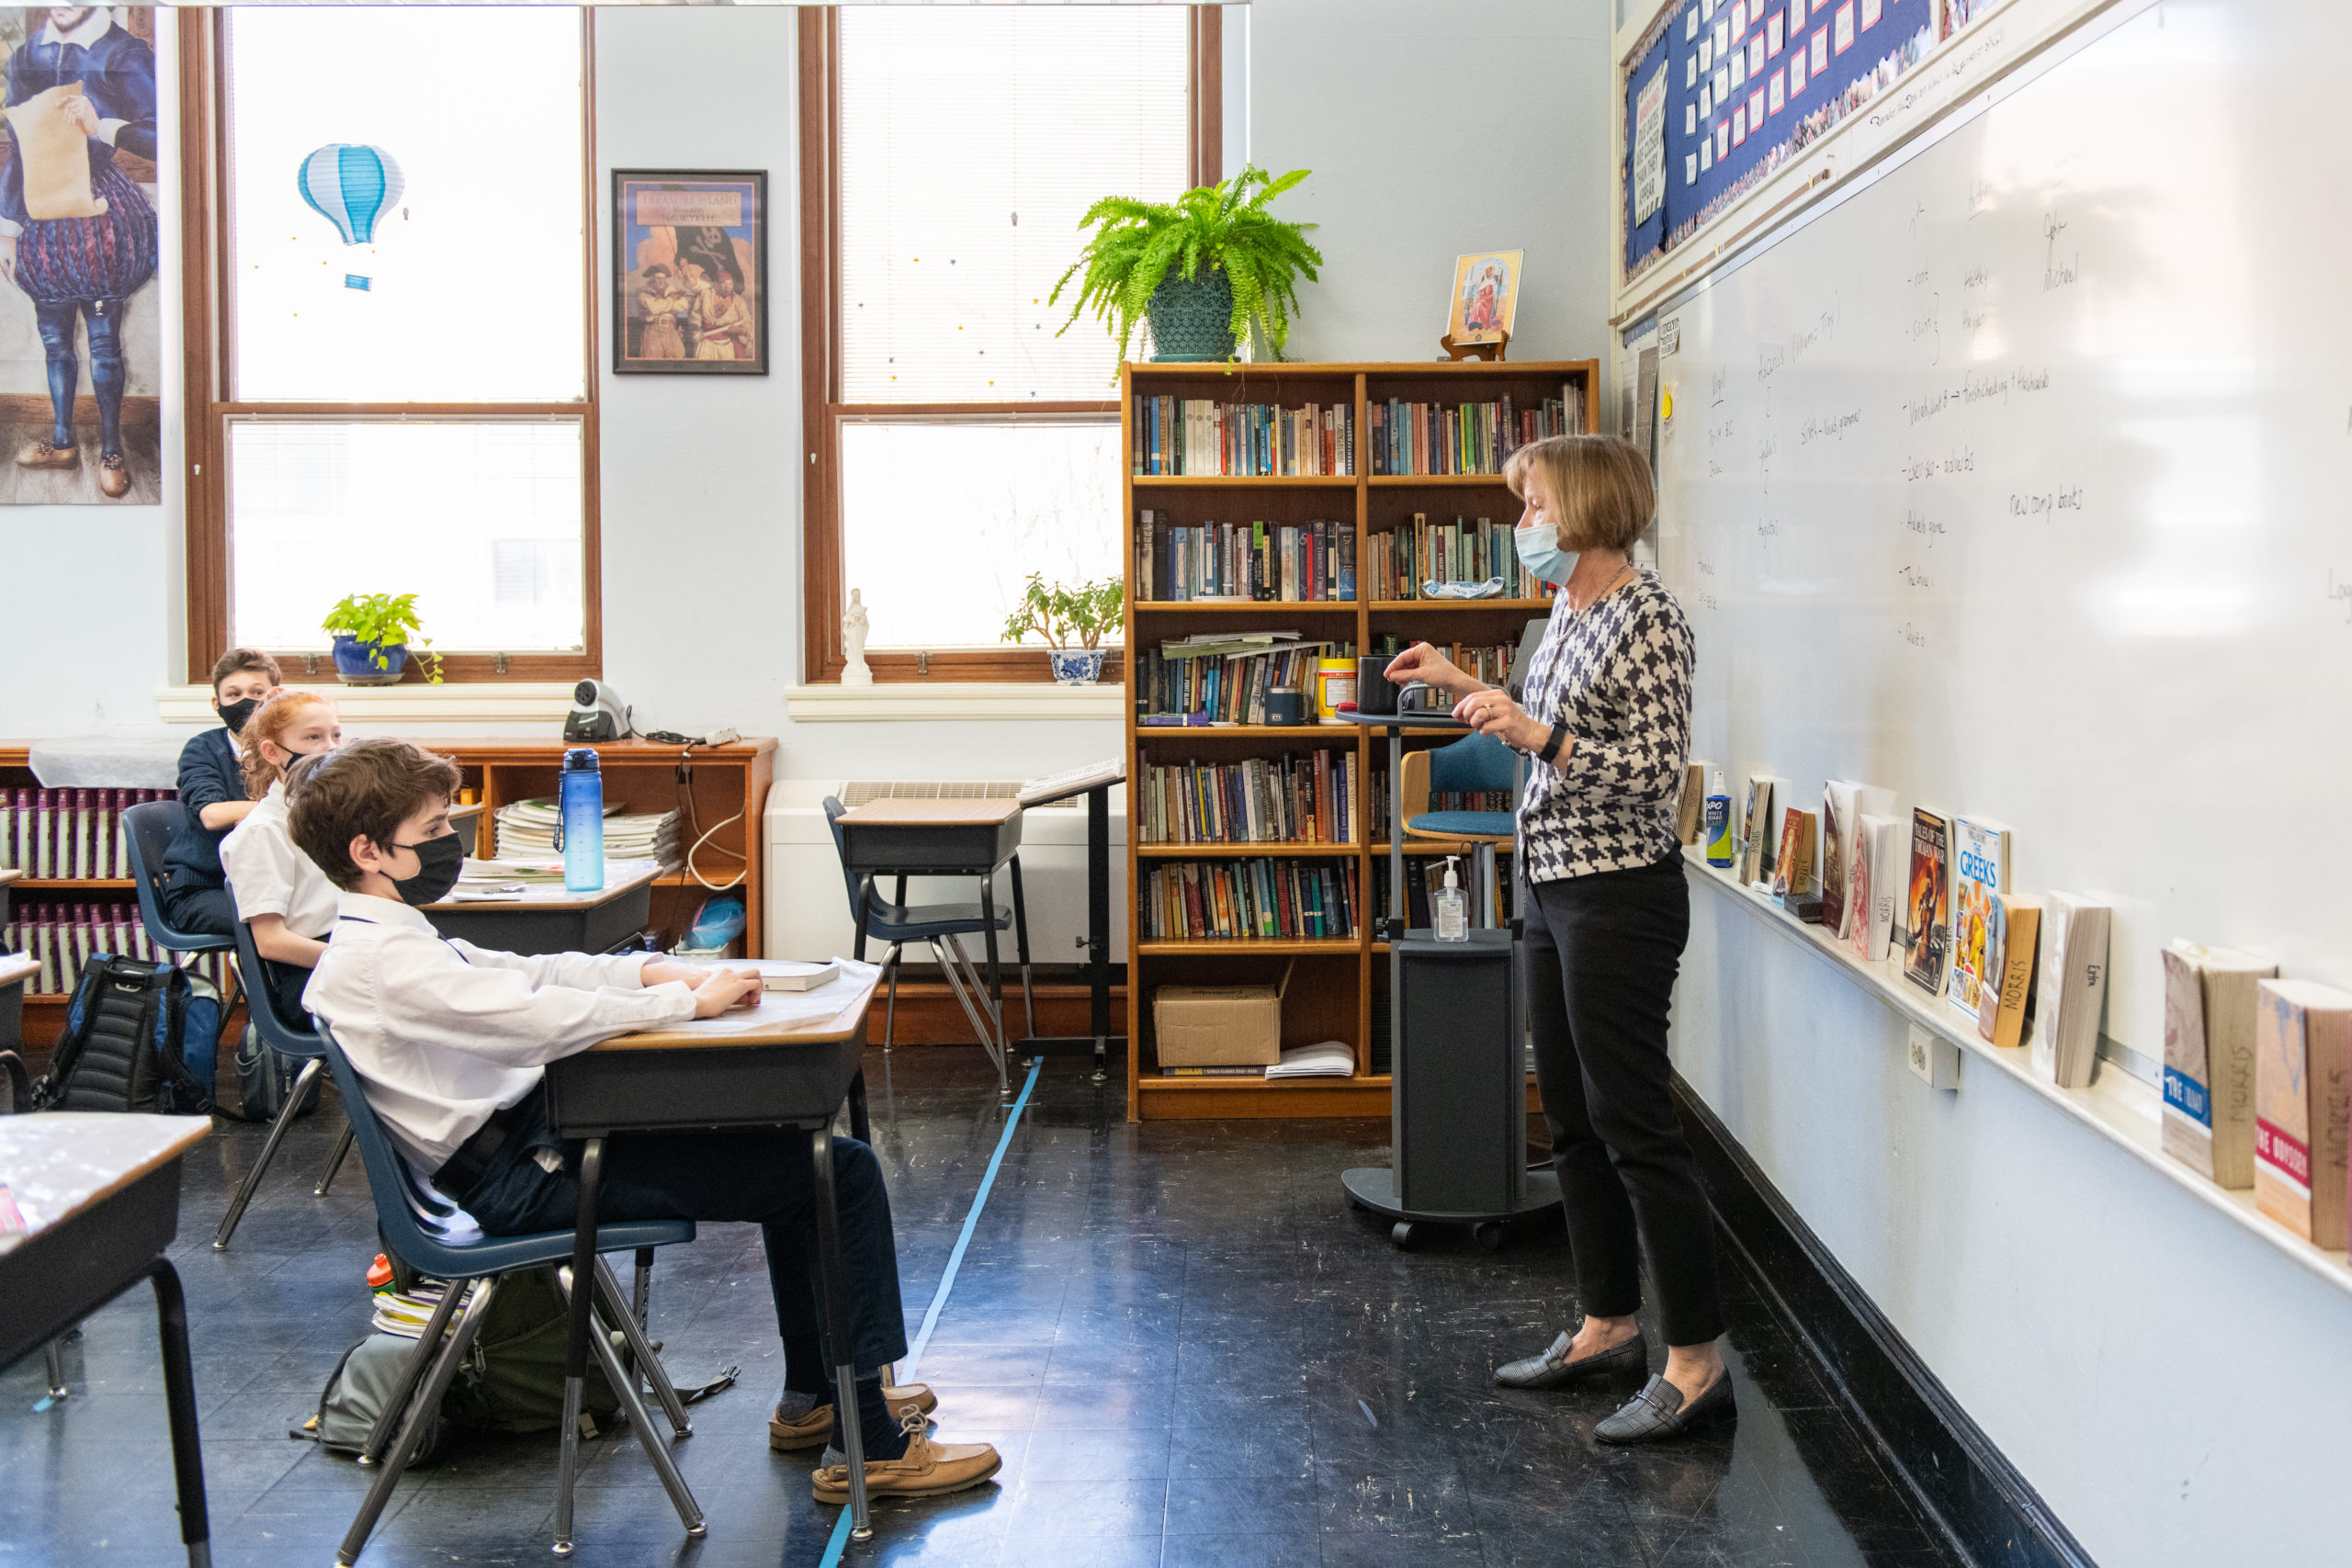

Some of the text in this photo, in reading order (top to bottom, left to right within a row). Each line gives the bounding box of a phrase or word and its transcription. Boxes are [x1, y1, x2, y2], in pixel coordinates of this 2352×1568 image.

[643, 195, 738, 206] TREASURE ISLAND
[2043, 251, 2078, 292] Michael
[1944, 445, 1973, 472] adverbs
[2010, 484, 2084, 525] new comp books
[1343, 535, 1353, 563] Dragon
[1915, 822, 1945, 848] TALES OF THE
[1973, 841, 1983, 856] THE
[1915, 838, 1946, 864] TROJAN WAR
[1960, 850, 1996, 888] GREEKS
[2004, 960, 2027, 1010] MORRIS
[2165, 1076, 2183, 1103] THE
